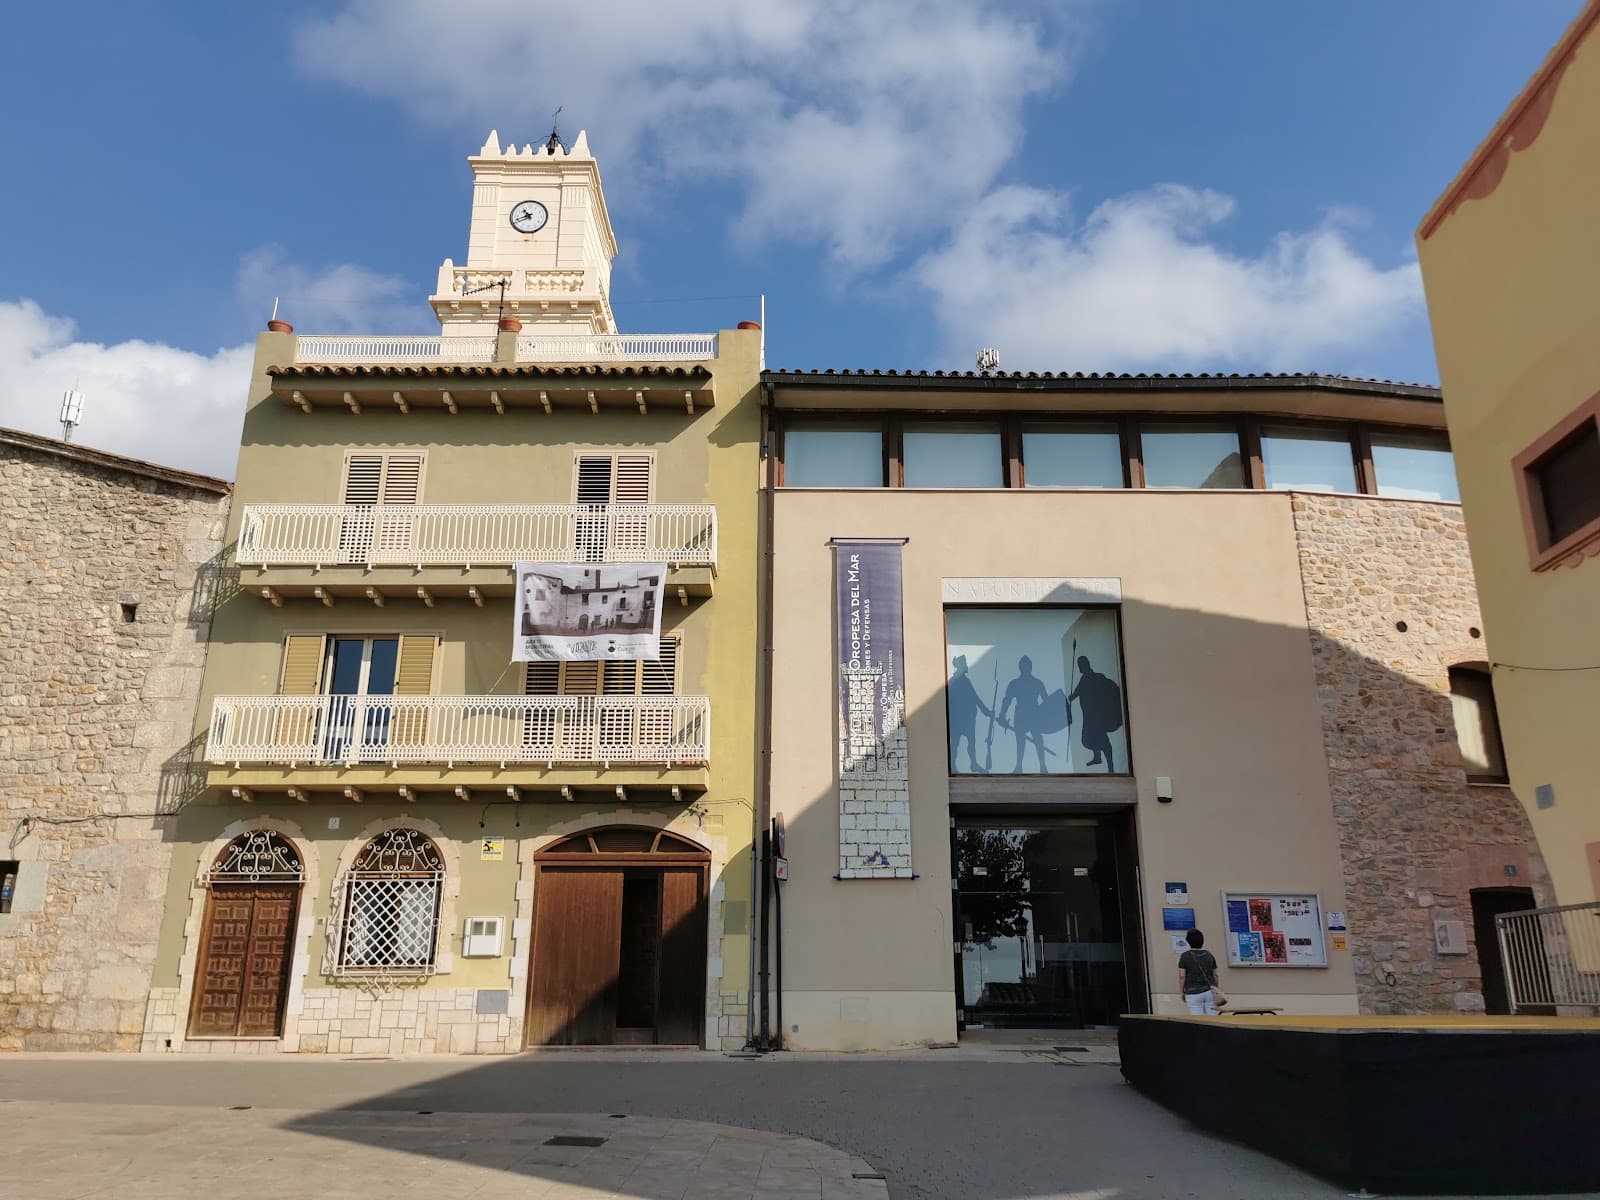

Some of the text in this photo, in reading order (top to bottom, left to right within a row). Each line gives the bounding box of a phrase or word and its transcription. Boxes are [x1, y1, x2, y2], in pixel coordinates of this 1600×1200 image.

[848, 554, 861, 741] MUSEO DE OROPESA DEL MAR
[863, 599, 871, 641] DEFENSAS
